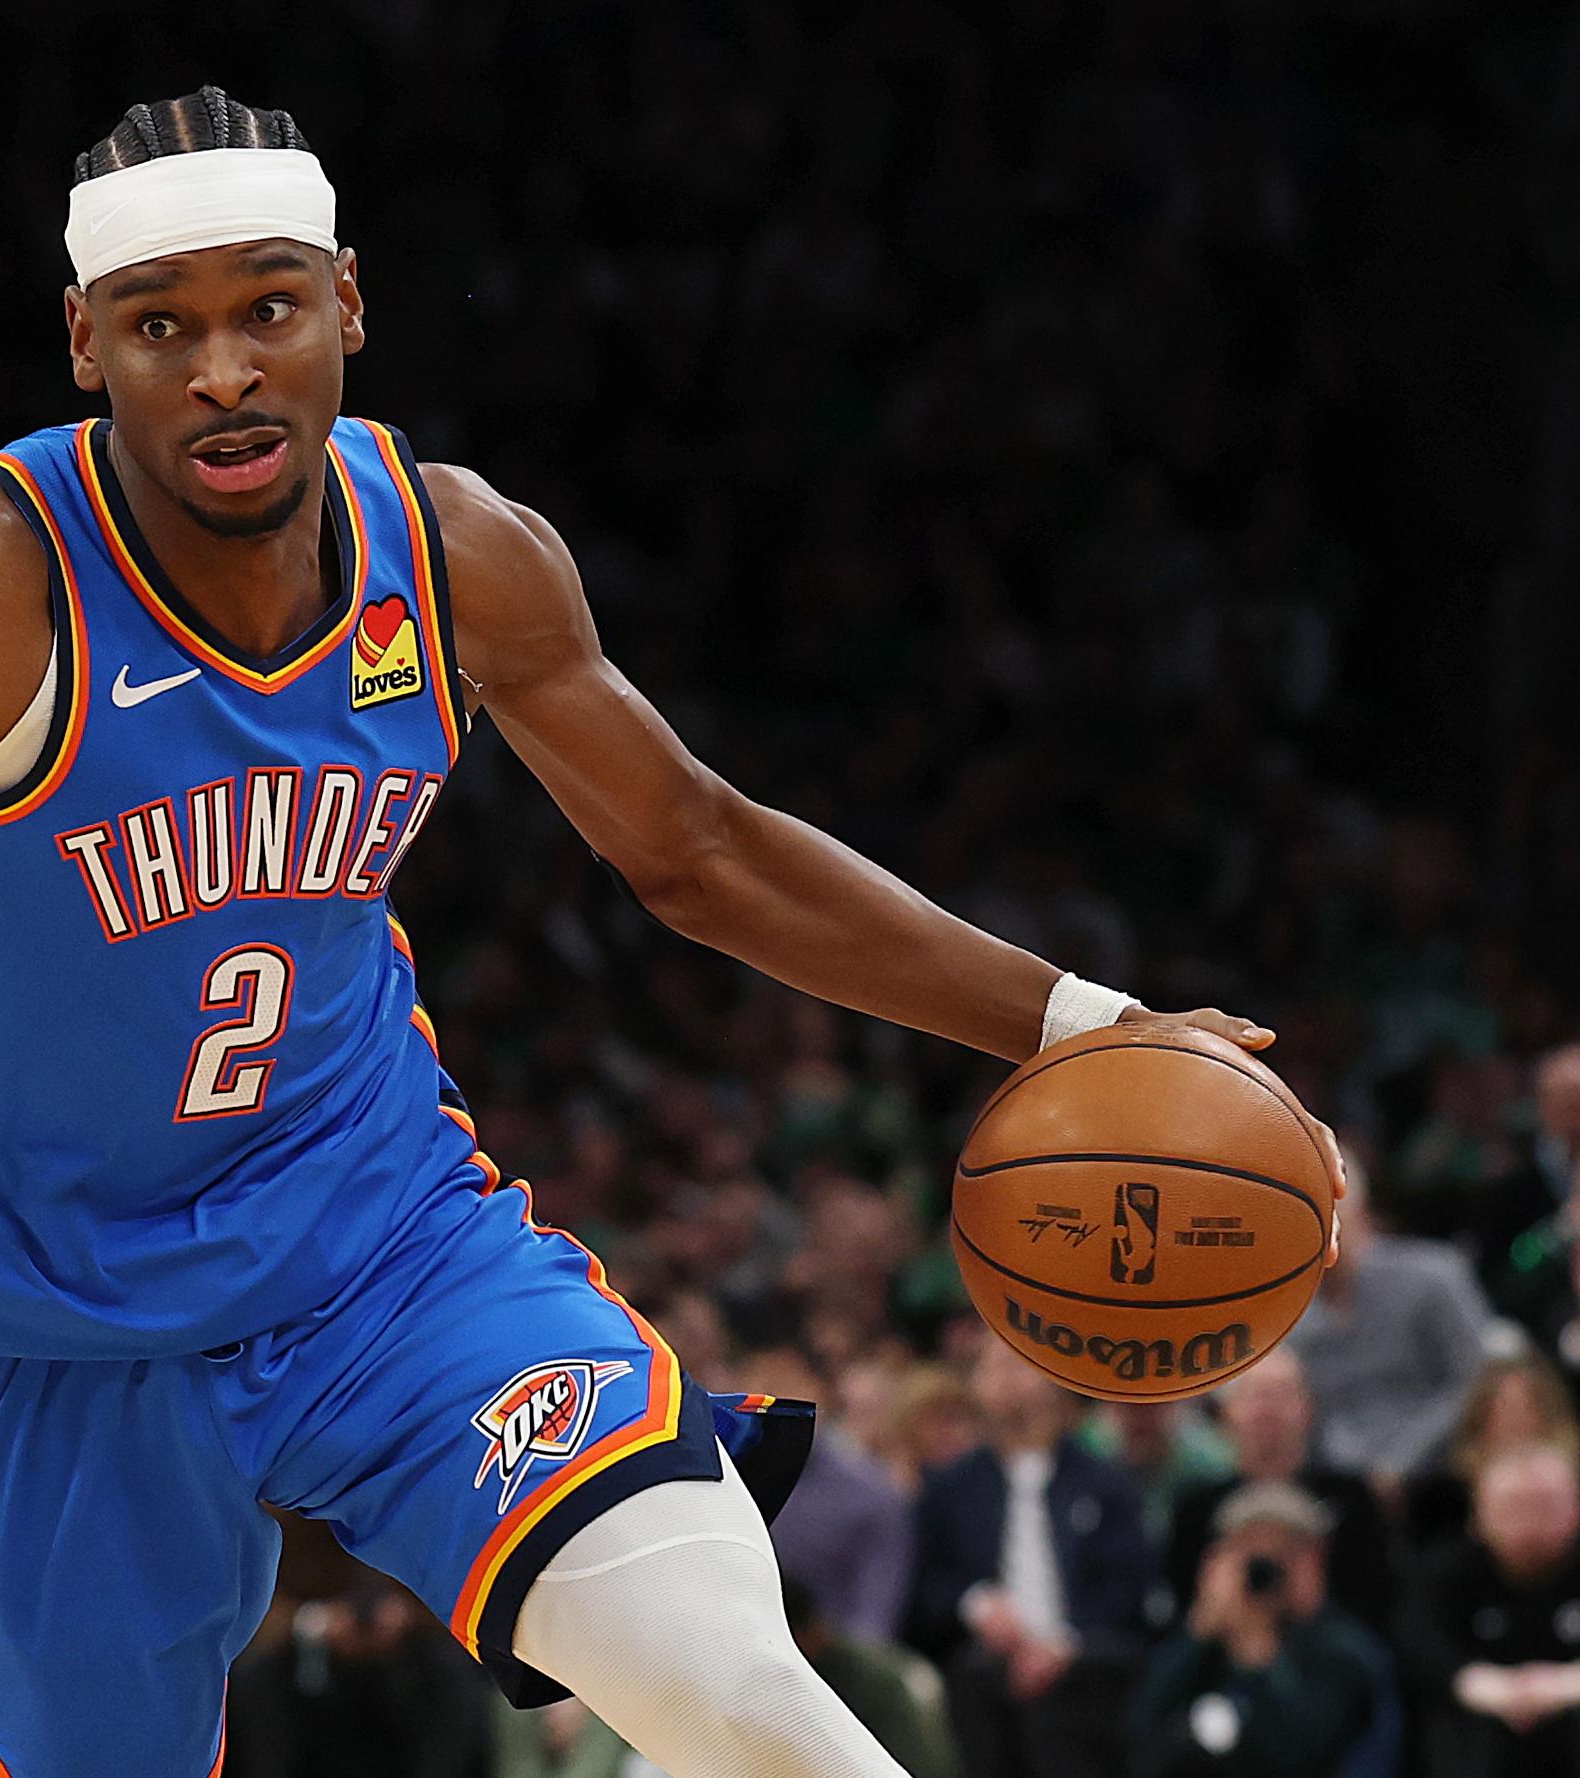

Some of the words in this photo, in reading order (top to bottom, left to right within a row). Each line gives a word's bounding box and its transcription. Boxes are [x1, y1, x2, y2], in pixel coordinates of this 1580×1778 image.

[54, 764, 443, 943] THUNDER
[172, 941, 296, 1124] 2
[1005, 1293, 1255, 1381] Wilson
[503, 1373, 571, 1471] OKC
